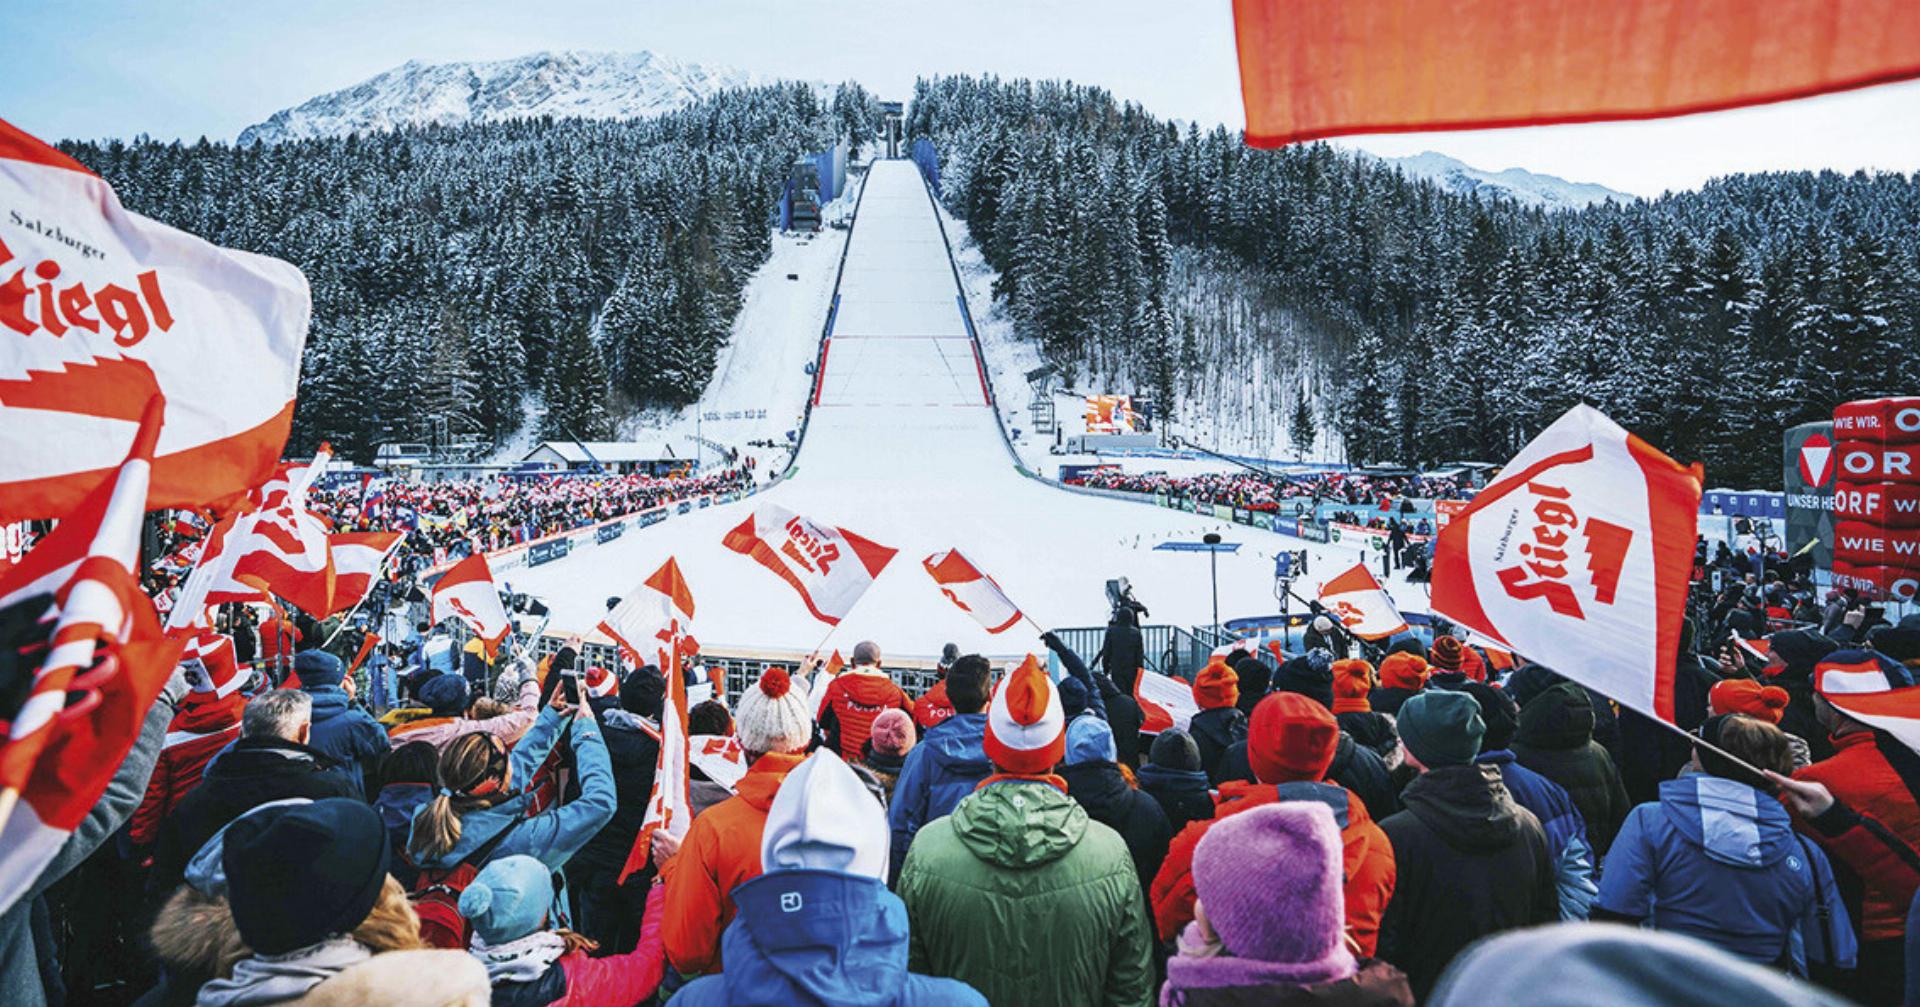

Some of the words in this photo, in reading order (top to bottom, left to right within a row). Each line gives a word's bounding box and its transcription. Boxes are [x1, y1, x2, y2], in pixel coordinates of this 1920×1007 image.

[10, 210, 106, 260] Salzburger
[0, 236, 175, 347] tiegl
[1787, 494, 1819, 510] UNSER
[1835, 489, 1881, 515] ORF
[1495, 480, 1586, 621] Stiegl
[1841, 536, 1885, 552] WIE
